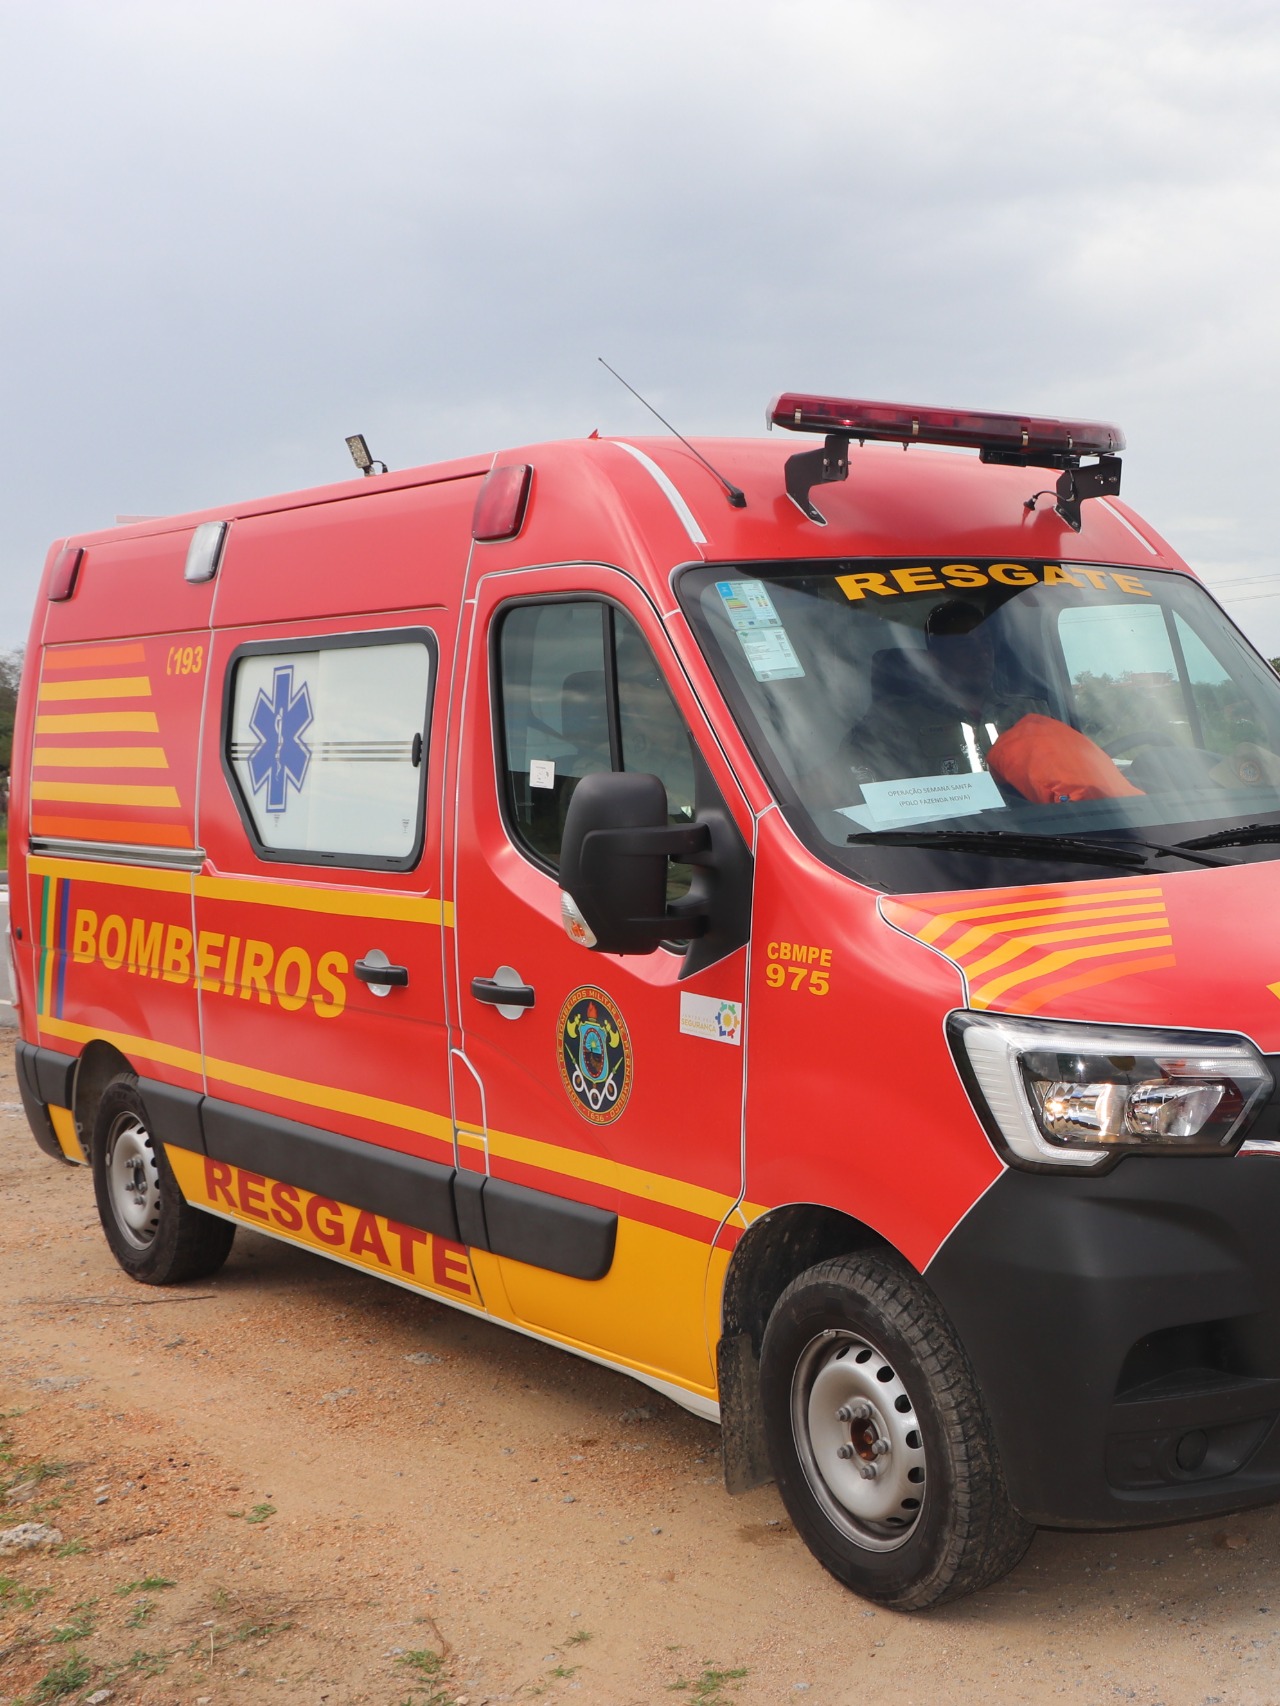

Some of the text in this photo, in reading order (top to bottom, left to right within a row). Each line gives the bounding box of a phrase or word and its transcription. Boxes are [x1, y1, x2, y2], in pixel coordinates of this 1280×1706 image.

[834, 563, 1152, 601] RESGATE
[174, 646, 203, 675] 193
[887, 782, 973, 797] OPERAÇÃO SEMANA SANTA
[899, 793, 971, 807] (POLO FAZENDA NOVA)
[73, 908, 348, 1018] BOMBEIROS
[767, 942, 833, 967] CBMPE
[766, 963, 830, 996] 975
[589, 990, 616, 1015] MILITAR
[203, 1156, 471, 1296] RESGATE
